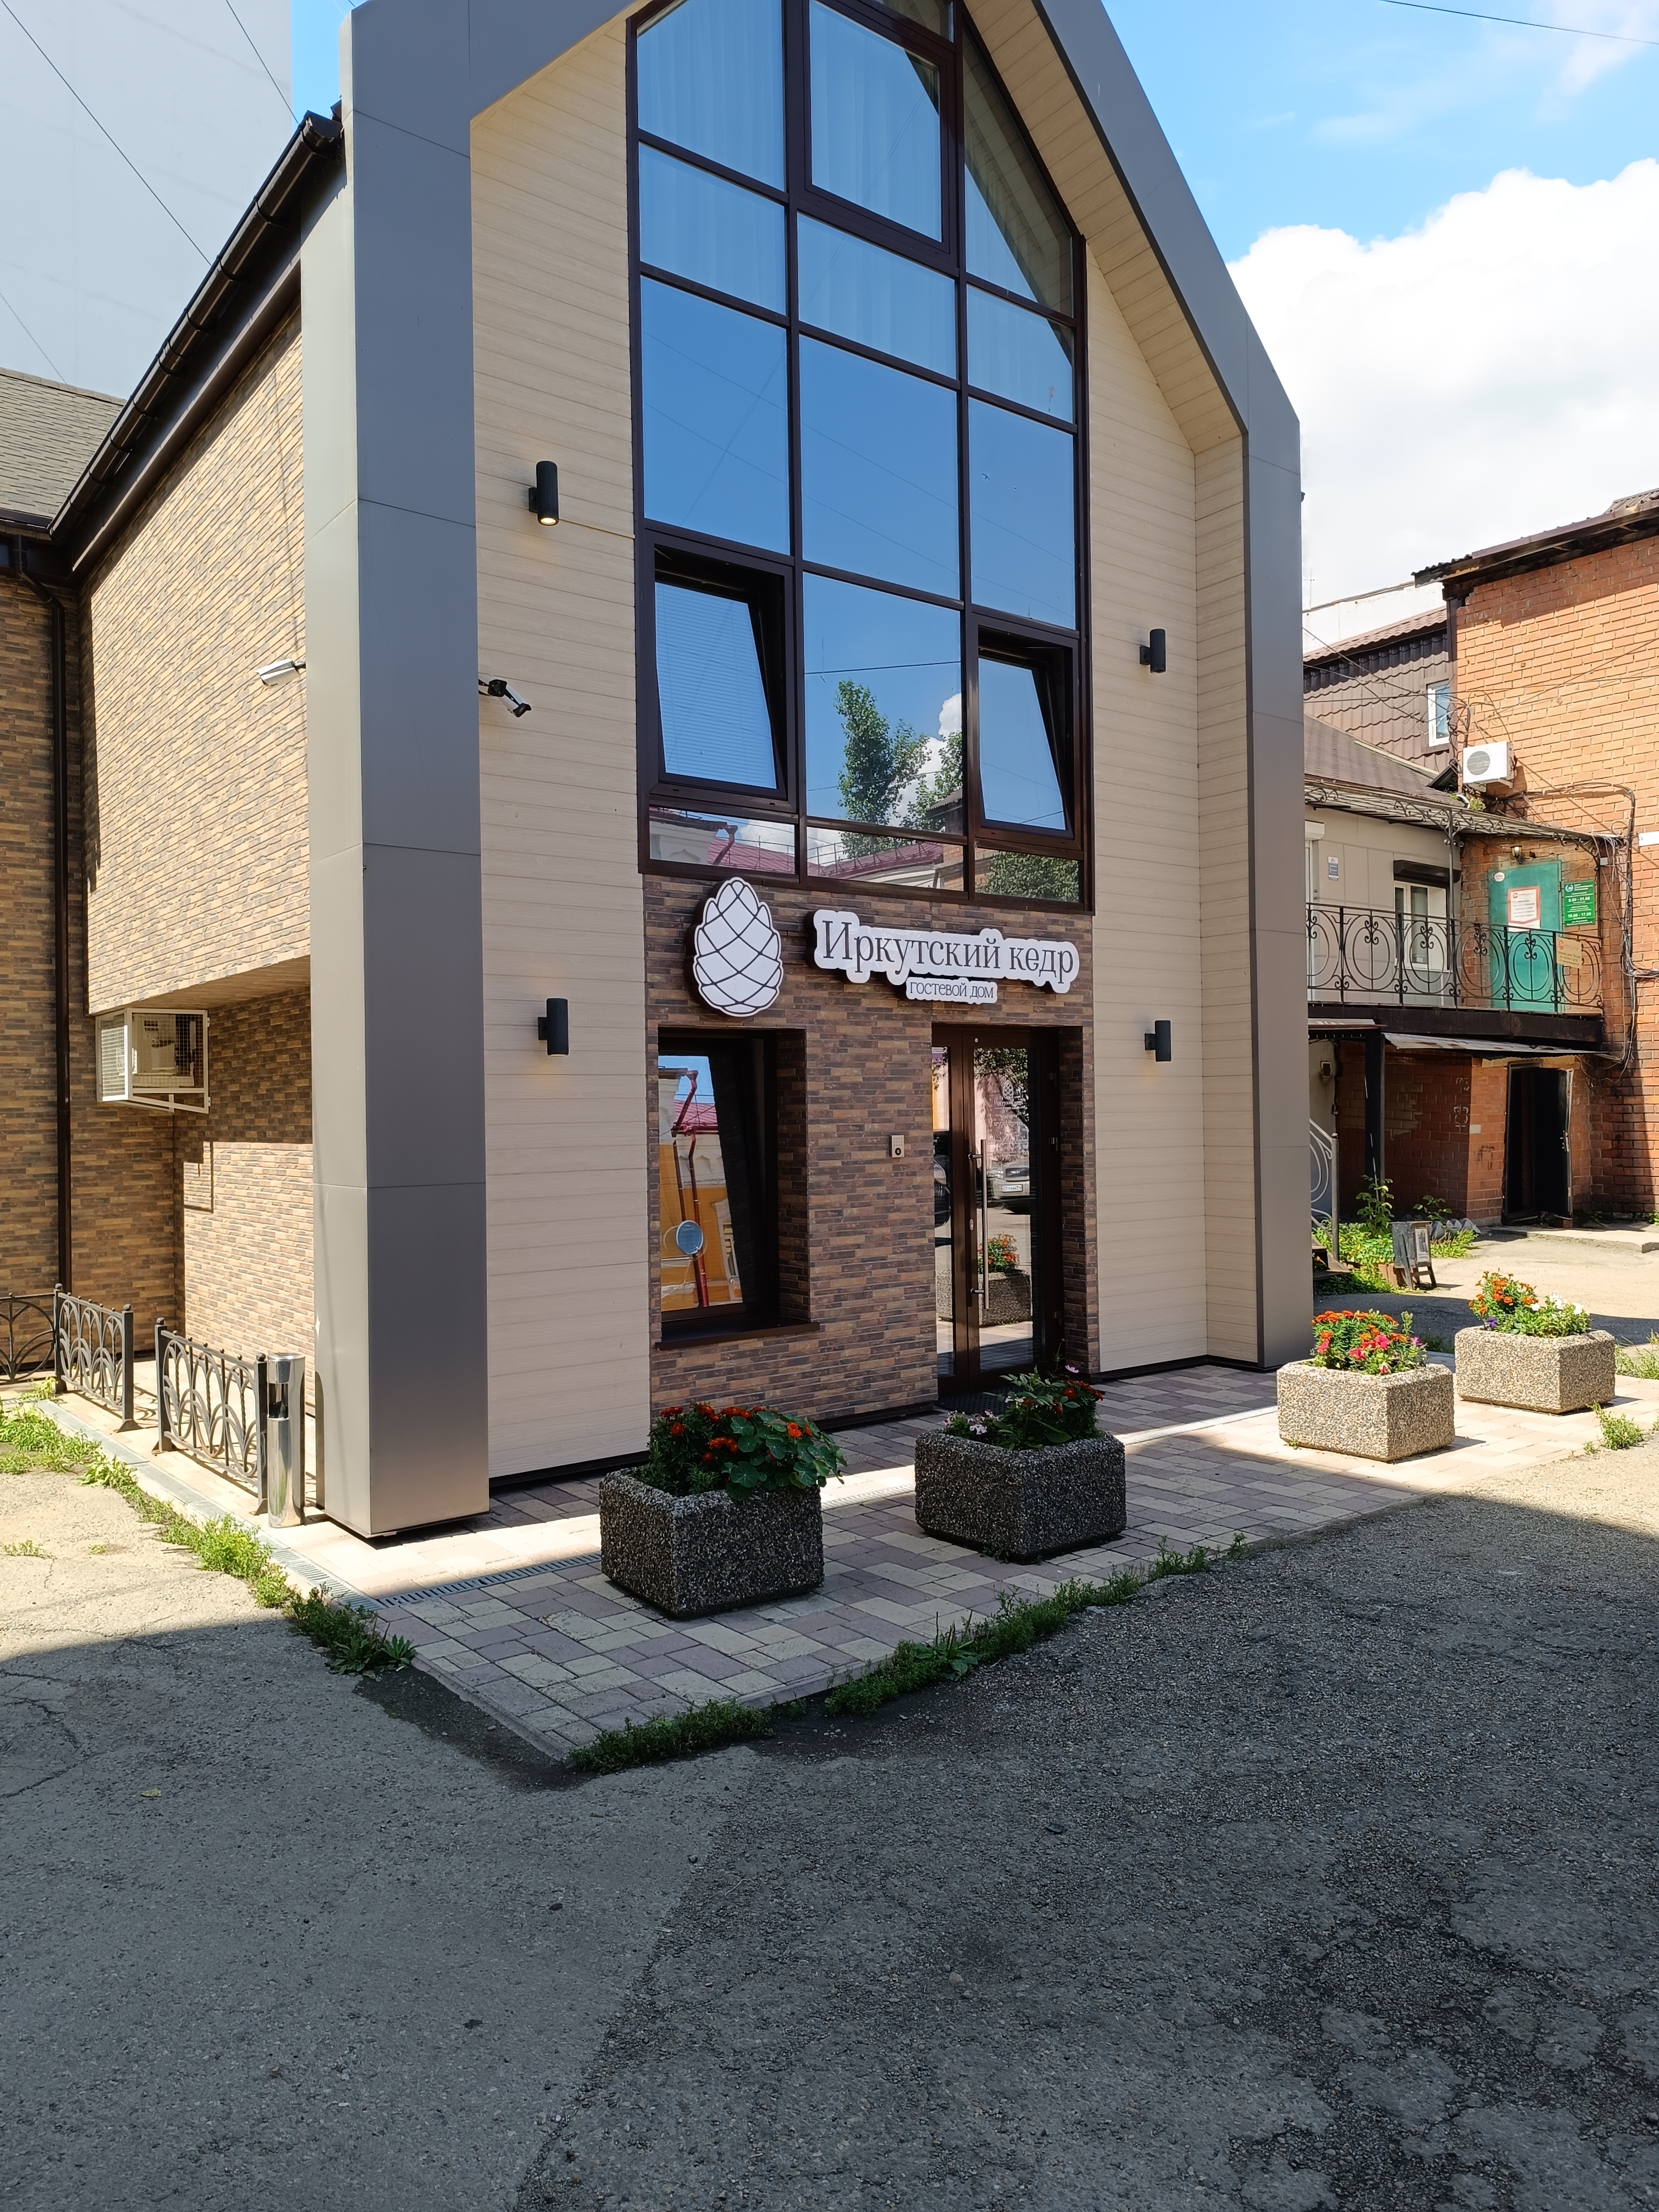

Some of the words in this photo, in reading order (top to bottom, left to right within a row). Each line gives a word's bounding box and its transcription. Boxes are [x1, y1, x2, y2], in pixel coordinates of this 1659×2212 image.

[822, 920, 1001, 975] Иркутский
[1009, 948, 1073, 984] кедр
[910, 982, 967, 998] гостевой
[969, 986, 994, 999] дом
